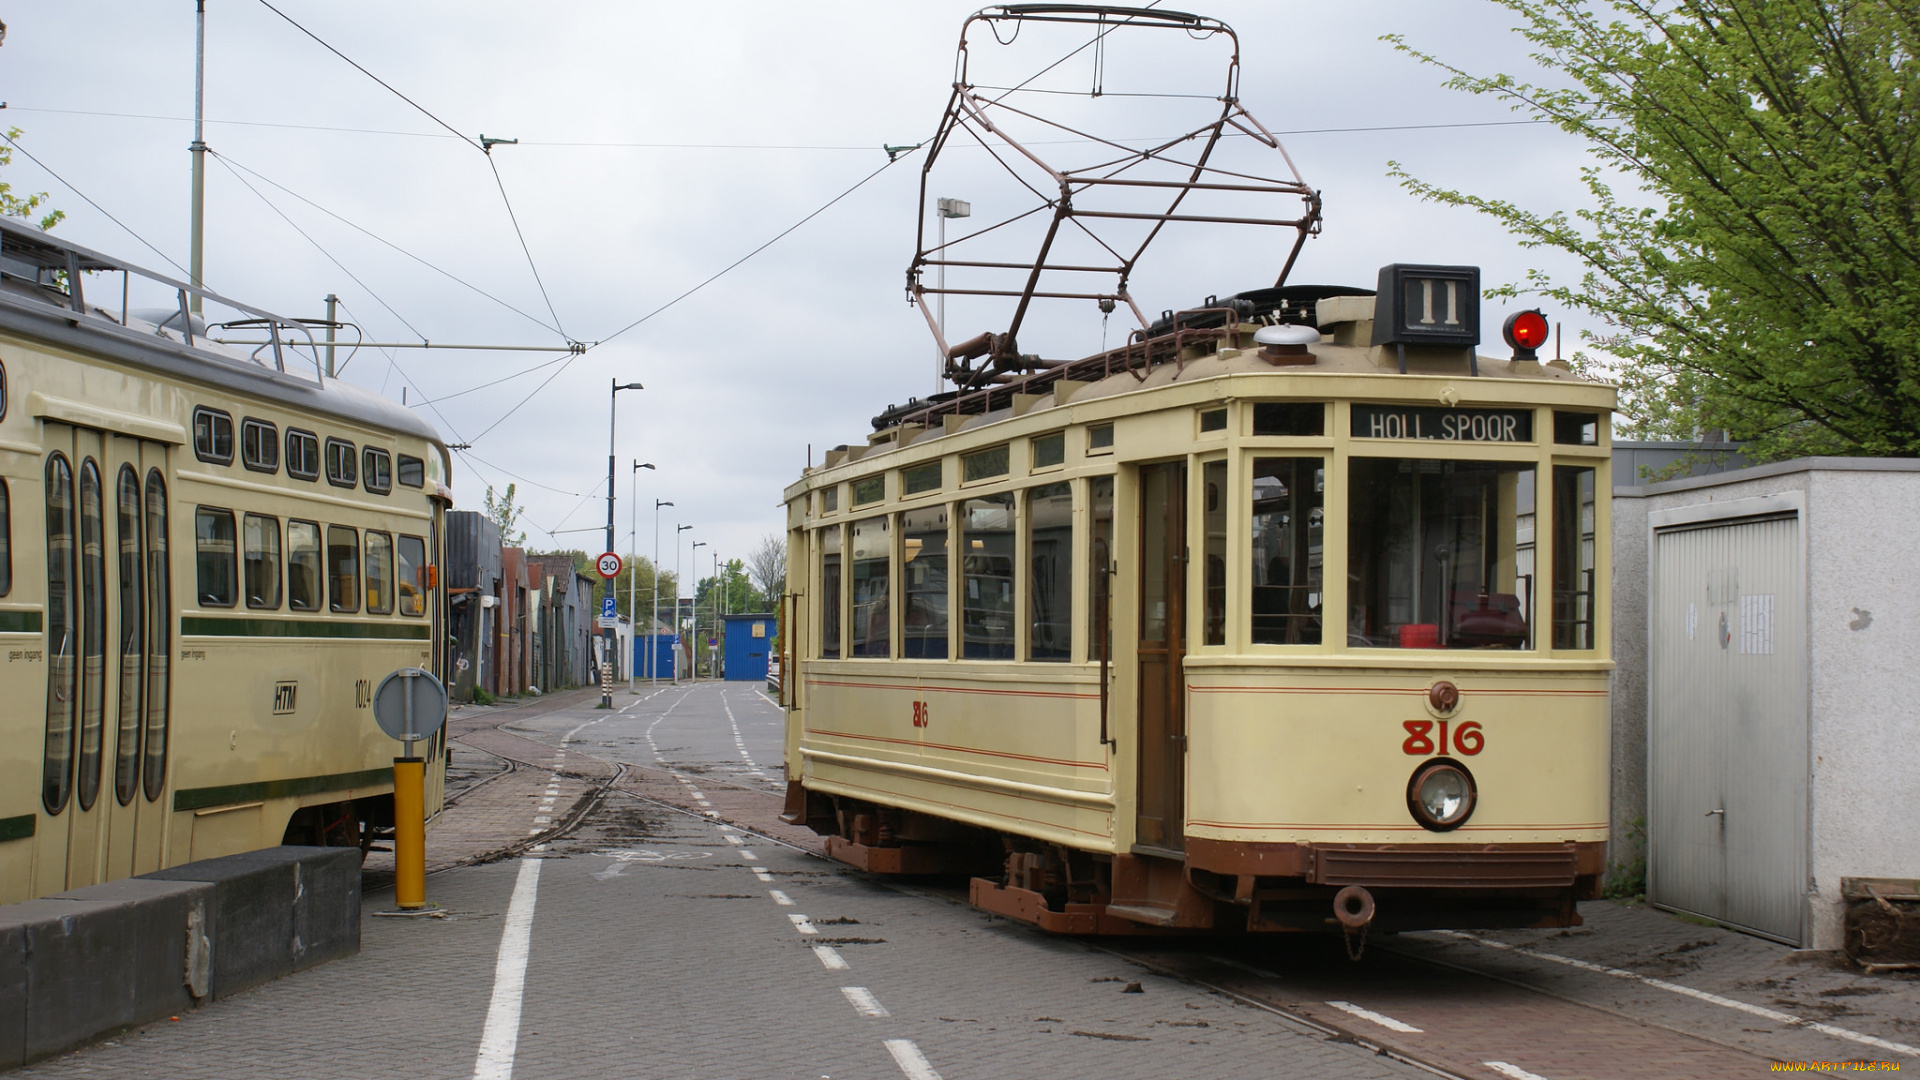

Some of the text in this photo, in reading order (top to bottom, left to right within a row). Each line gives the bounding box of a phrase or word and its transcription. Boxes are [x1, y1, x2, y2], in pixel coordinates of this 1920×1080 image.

[1420, 279, 1459, 325] 11
[1370, 413, 1517, 442] HOLL. SPOOR
[601, 560, 617, 571] 30
[605, 599, 613, 610] P
[9, 648, 42, 662] geen ingang
[275, 685, 297, 711] HTM
[355, 679, 371, 709] 1024
[912, 700, 929, 729] 816
[1402, 720, 1485, 756] 816
